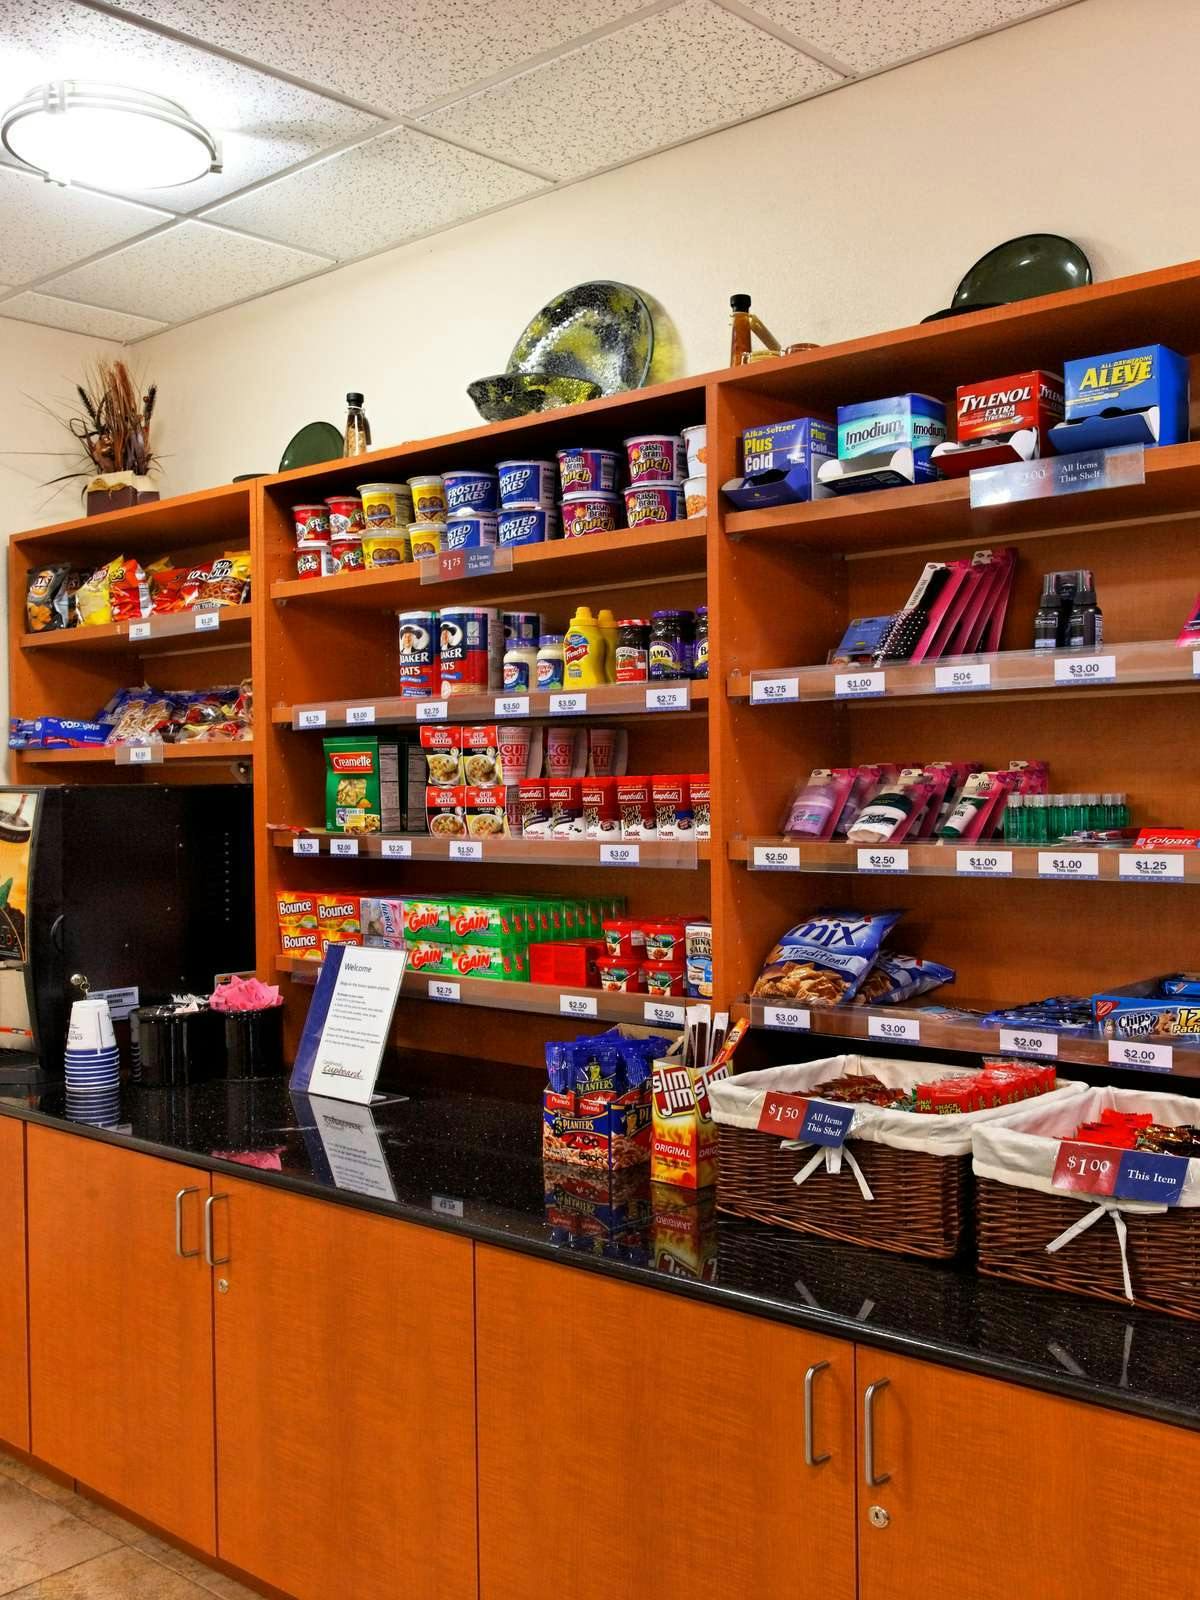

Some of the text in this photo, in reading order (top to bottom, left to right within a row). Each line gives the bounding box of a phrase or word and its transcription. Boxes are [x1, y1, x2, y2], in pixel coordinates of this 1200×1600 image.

[1079, 361, 1153, 391] ALEVE
[960, 386, 1031, 415] TYLENOL
[984, 403, 1015, 417] EXTRA
[744, 423, 796, 438] Alka-Seltzer
[845, 419, 903, 445] Imodium
[744, 437, 773, 453] Plus
[744, 453, 774, 473] Cold
[1060, 460, 1099, 473] All Items
[1058, 469, 1101, 484] This Shelf
[448, 481, 492, 499] FROSTED
[449, 490, 486, 507] FLAKES
[573, 517, 615, 536] Crunch
[652, 649, 671, 659] AMA
[1069, 663, 1100, 674] $3.00
[953, 671, 972, 682] 50¢
[763, 685, 786, 695] $2.75
[847, 679, 872, 689] $1.00
[558, 699, 576, 708] $3.50
[656, 695, 677, 704] $2.75
[424, 707, 440, 715] $2.75
[502, 702, 520, 711] $3.50
[333, 755, 372, 770] Creamette
[1146, 835, 1196, 847] Colgate
[457, 846, 474, 854] $1.50
[609, 850, 630, 858] $3.00
[765, 852, 789, 863] $2.50
[869, 855, 895, 866] $2.50
[969, 857, 998, 868] $1.00
[1052, 859, 1083, 870] $1.00
[1135, 860, 1168, 870] $1.25
[279, 900, 313, 917] Bounce
[318, 903, 355, 920] Bounce
[408, 911, 440, 933] GAIN
[456, 913, 490, 936] GAIN
[786, 922, 868, 947] mix
[284, 933, 317, 950] Bounce
[691, 938, 712, 947] TUNA
[411, 948, 443, 969] GAIN
[458, 951, 492, 974] GAIN
[788, 946, 852, 967] Traditional
[344, 962, 373, 974] Welcome
[436, 986, 453, 995] $2.75
[568, 1000, 587, 1010] $2.50
[654, 1008, 675, 1019] $2.50
[774, 1013, 799, 1024] $3.00
[1119, 1011, 1152, 1029] Chips
[880, 1023, 906, 1035] $3.00
[1013, 1036, 1043, 1049] $2.00
[1124, 1048, 1156, 1061] $2.00
[563, 1119, 594, 1131] PLANTERS
[810, 1112, 844, 1127] All Items
[806, 1122, 842, 1138] This Shelf
[655, 1142, 692, 1159] ORIGINAL
[1127, 1168, 1178, 1186] This Item
